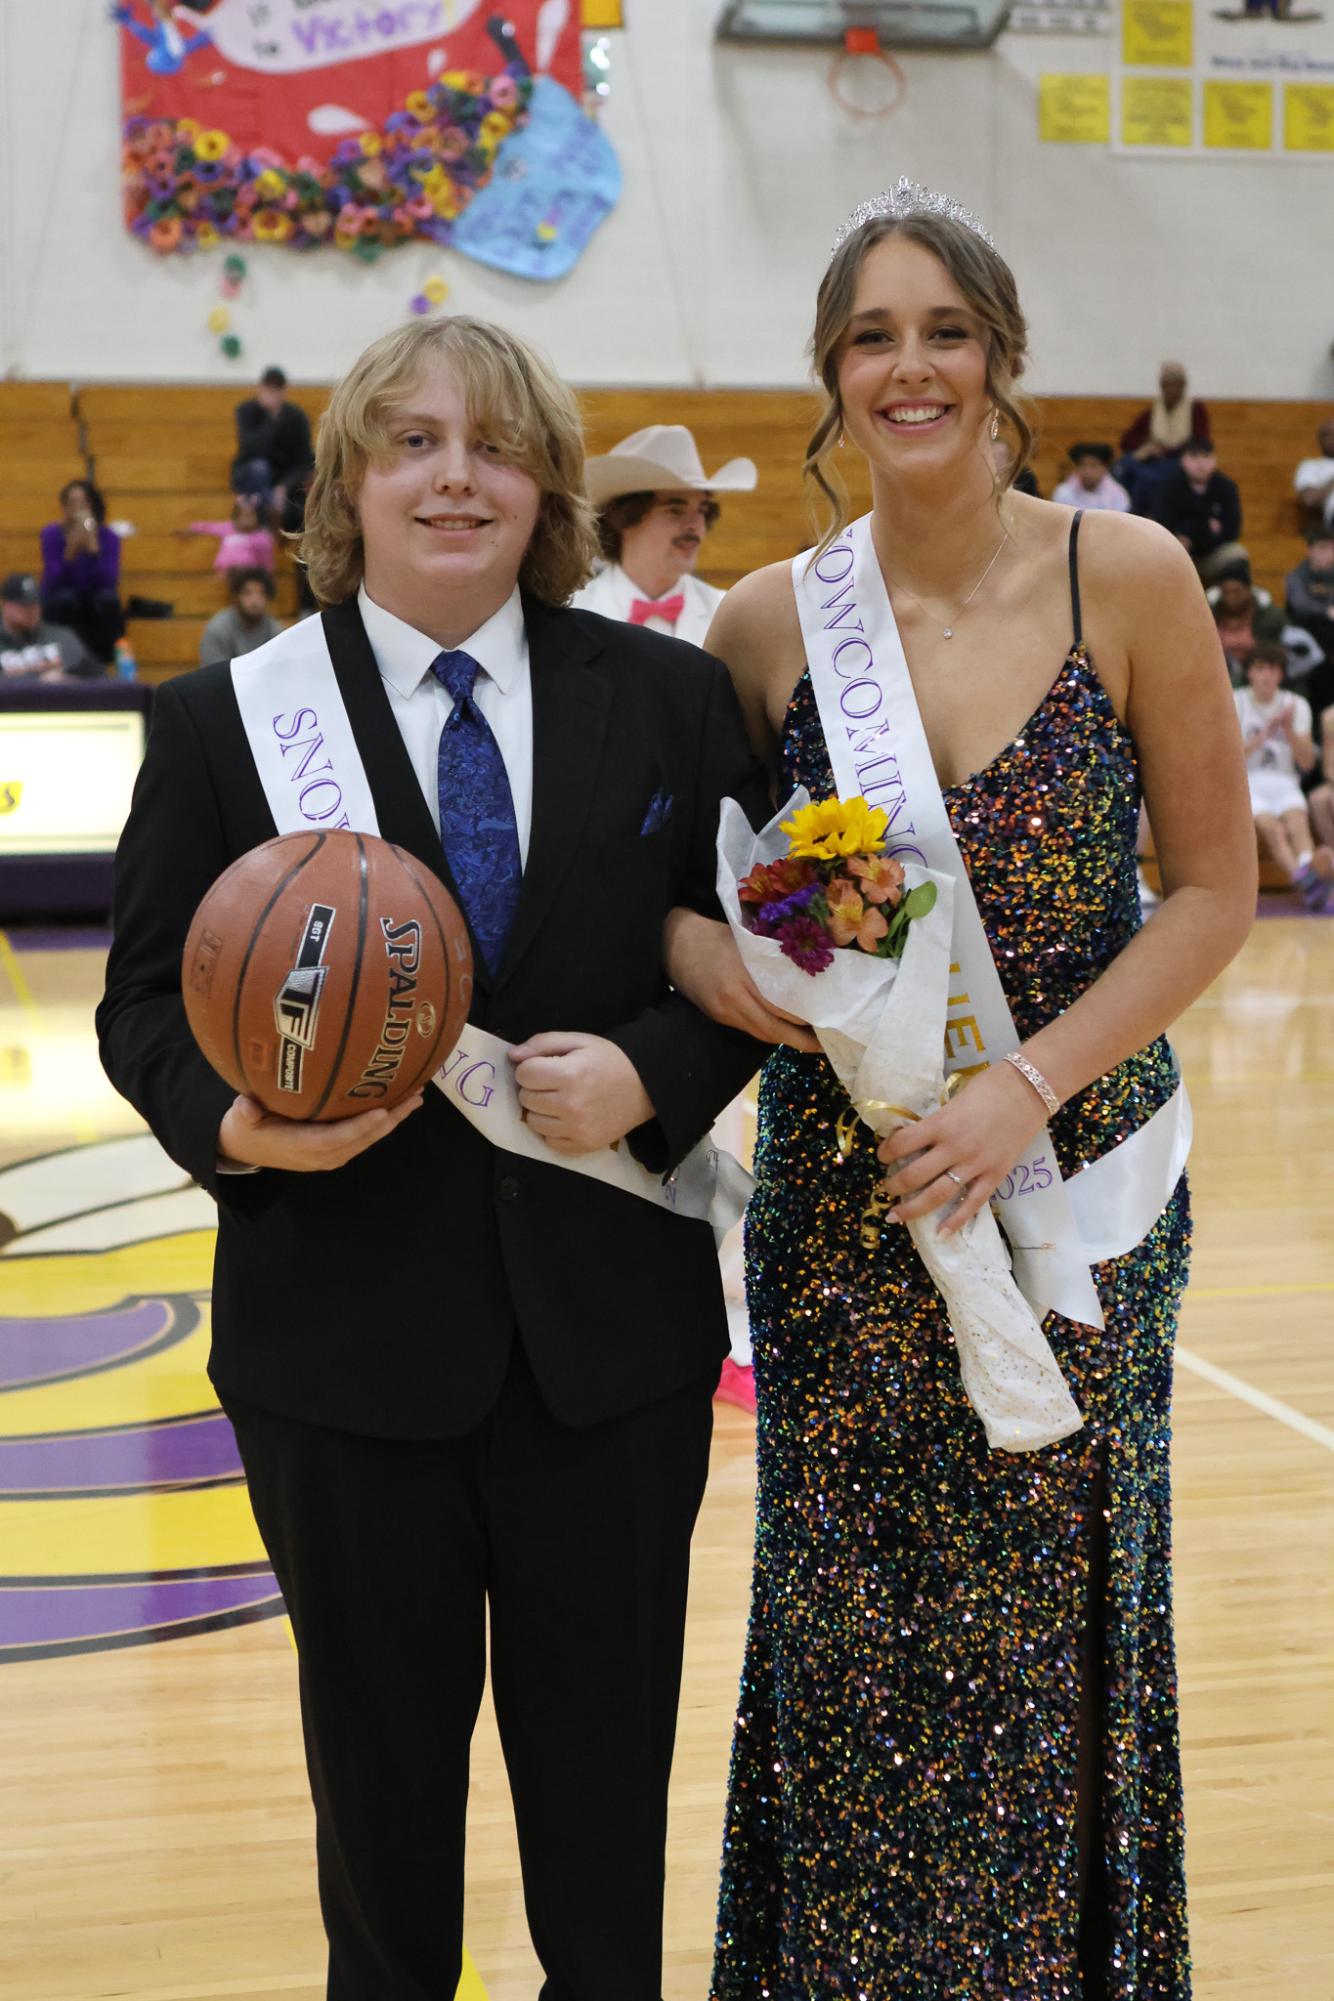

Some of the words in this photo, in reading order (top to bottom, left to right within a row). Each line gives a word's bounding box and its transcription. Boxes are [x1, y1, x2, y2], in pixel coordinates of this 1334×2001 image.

[276, 969, 326, 1046] TF
[348, 916, 422, 1099] SPALDING
[283, 1042, 296, 1091] COMPOSITE
[988, 1156, 1053, 1201] 025
